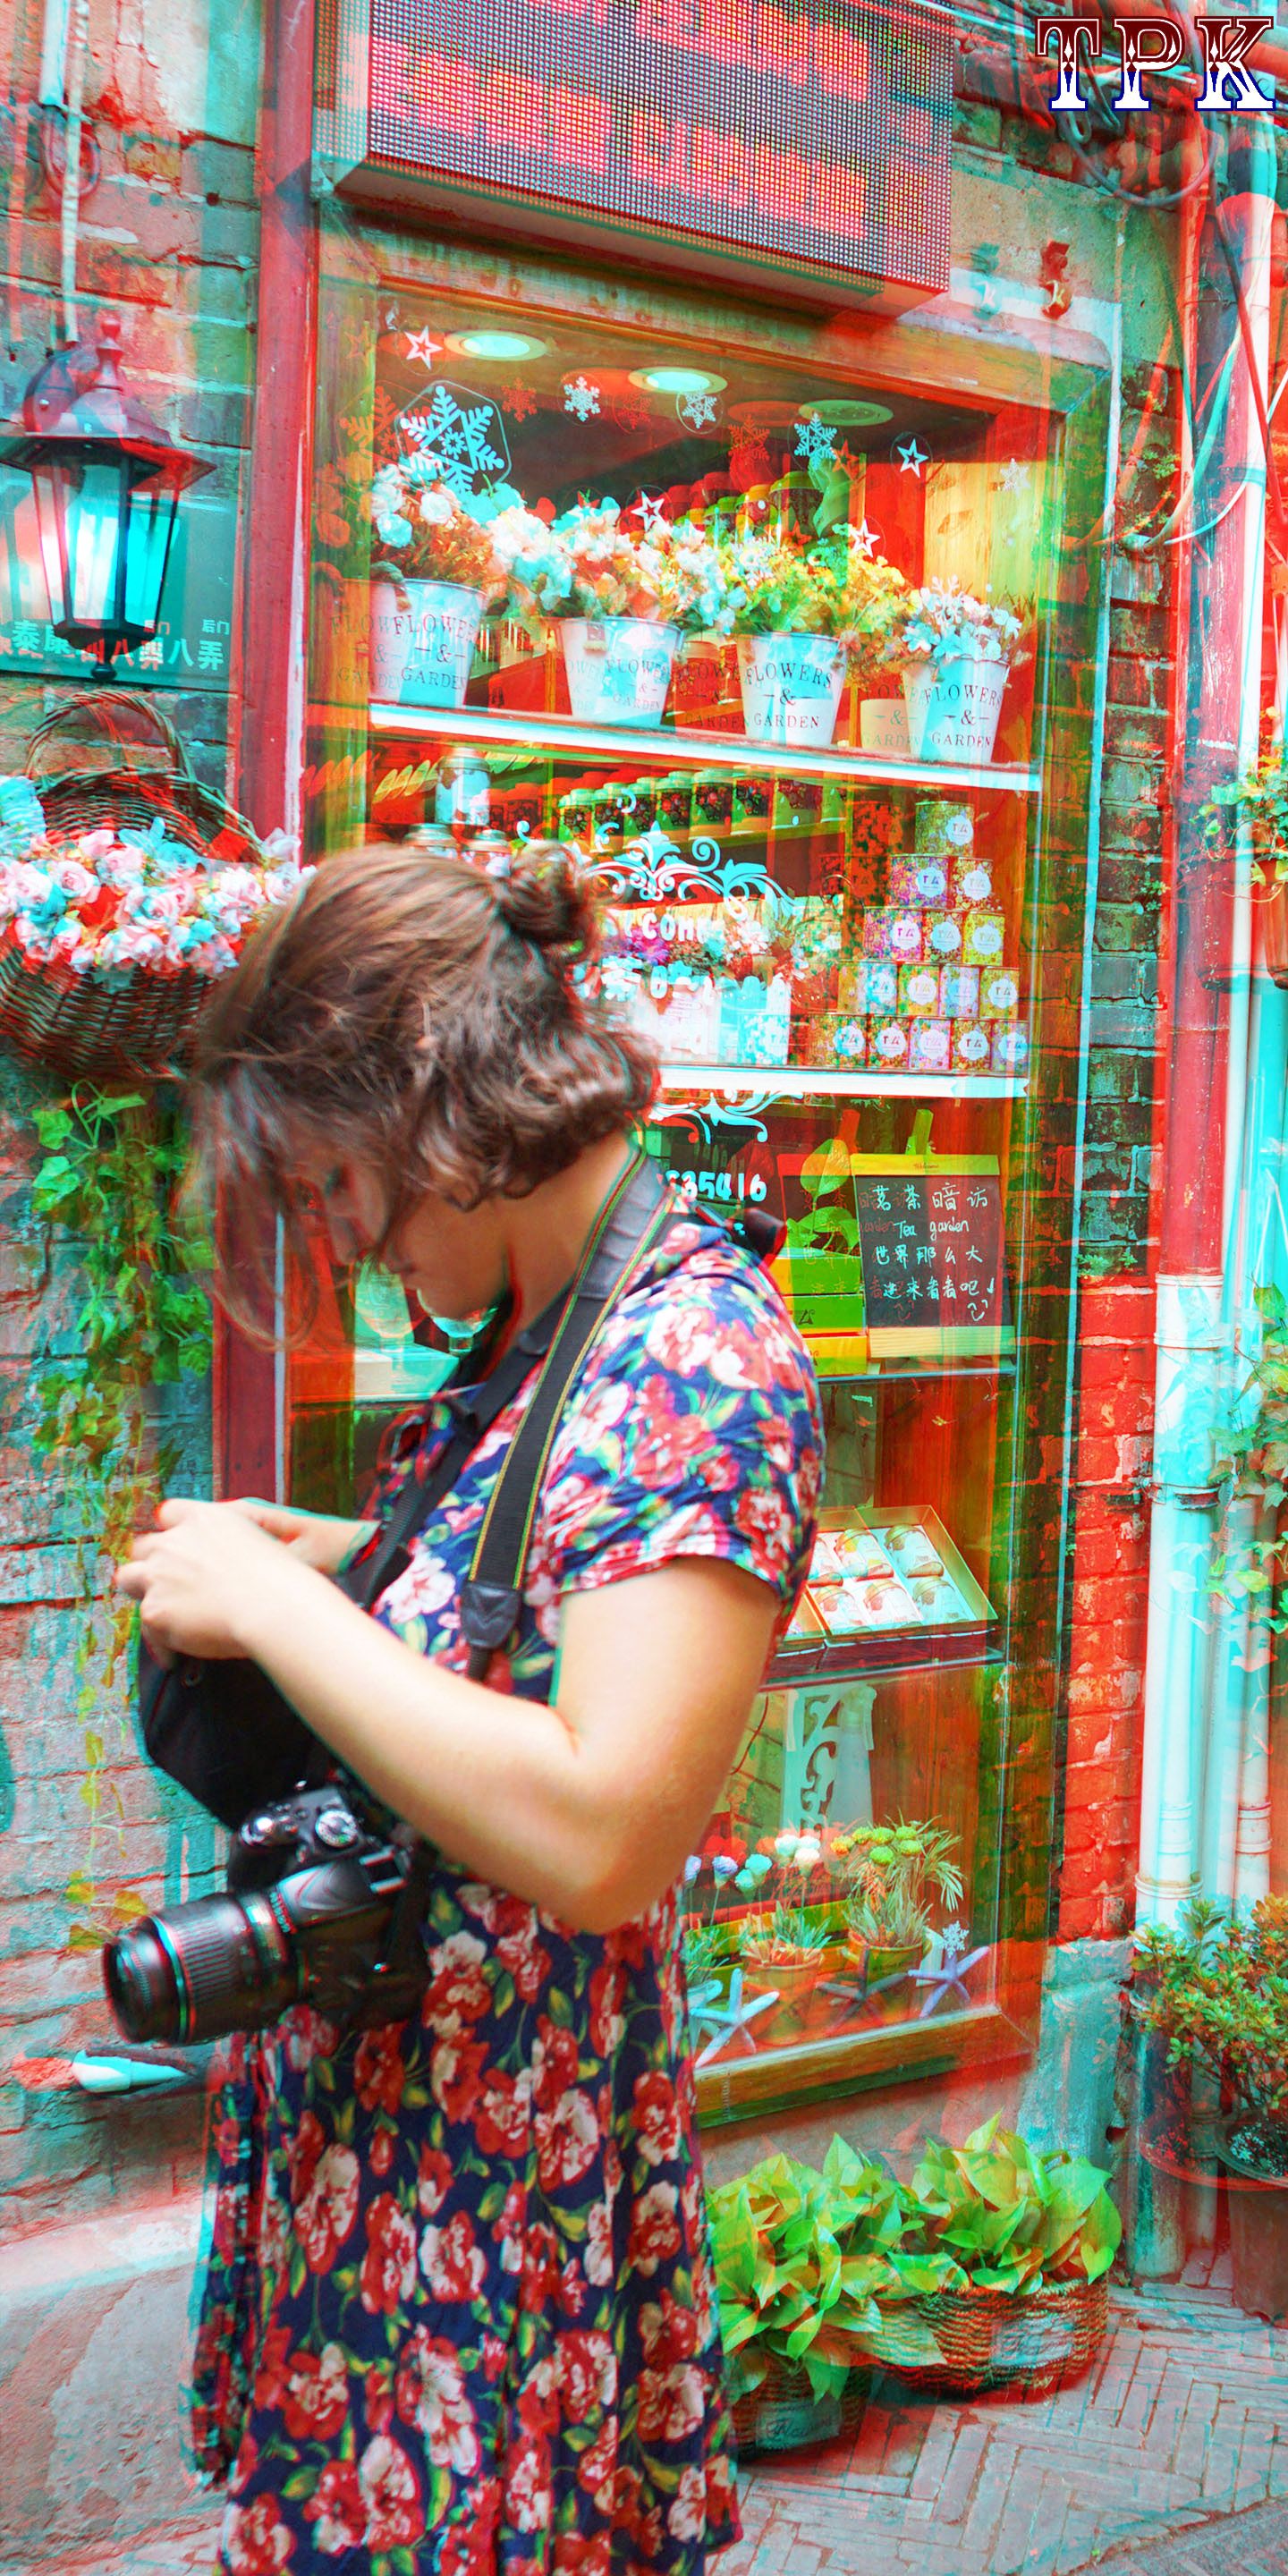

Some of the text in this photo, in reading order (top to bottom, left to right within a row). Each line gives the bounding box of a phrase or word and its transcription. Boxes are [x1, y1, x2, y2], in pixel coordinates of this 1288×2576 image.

[745, 662, 834, 690] FLOWERS
[753, 712, 821, 729] GARDEN
[931, 732, 993, 749] GARDEN
[894, 1216, 970, 1241] Tea garden
[875, 1244, 984, 1270] 世界那么大
